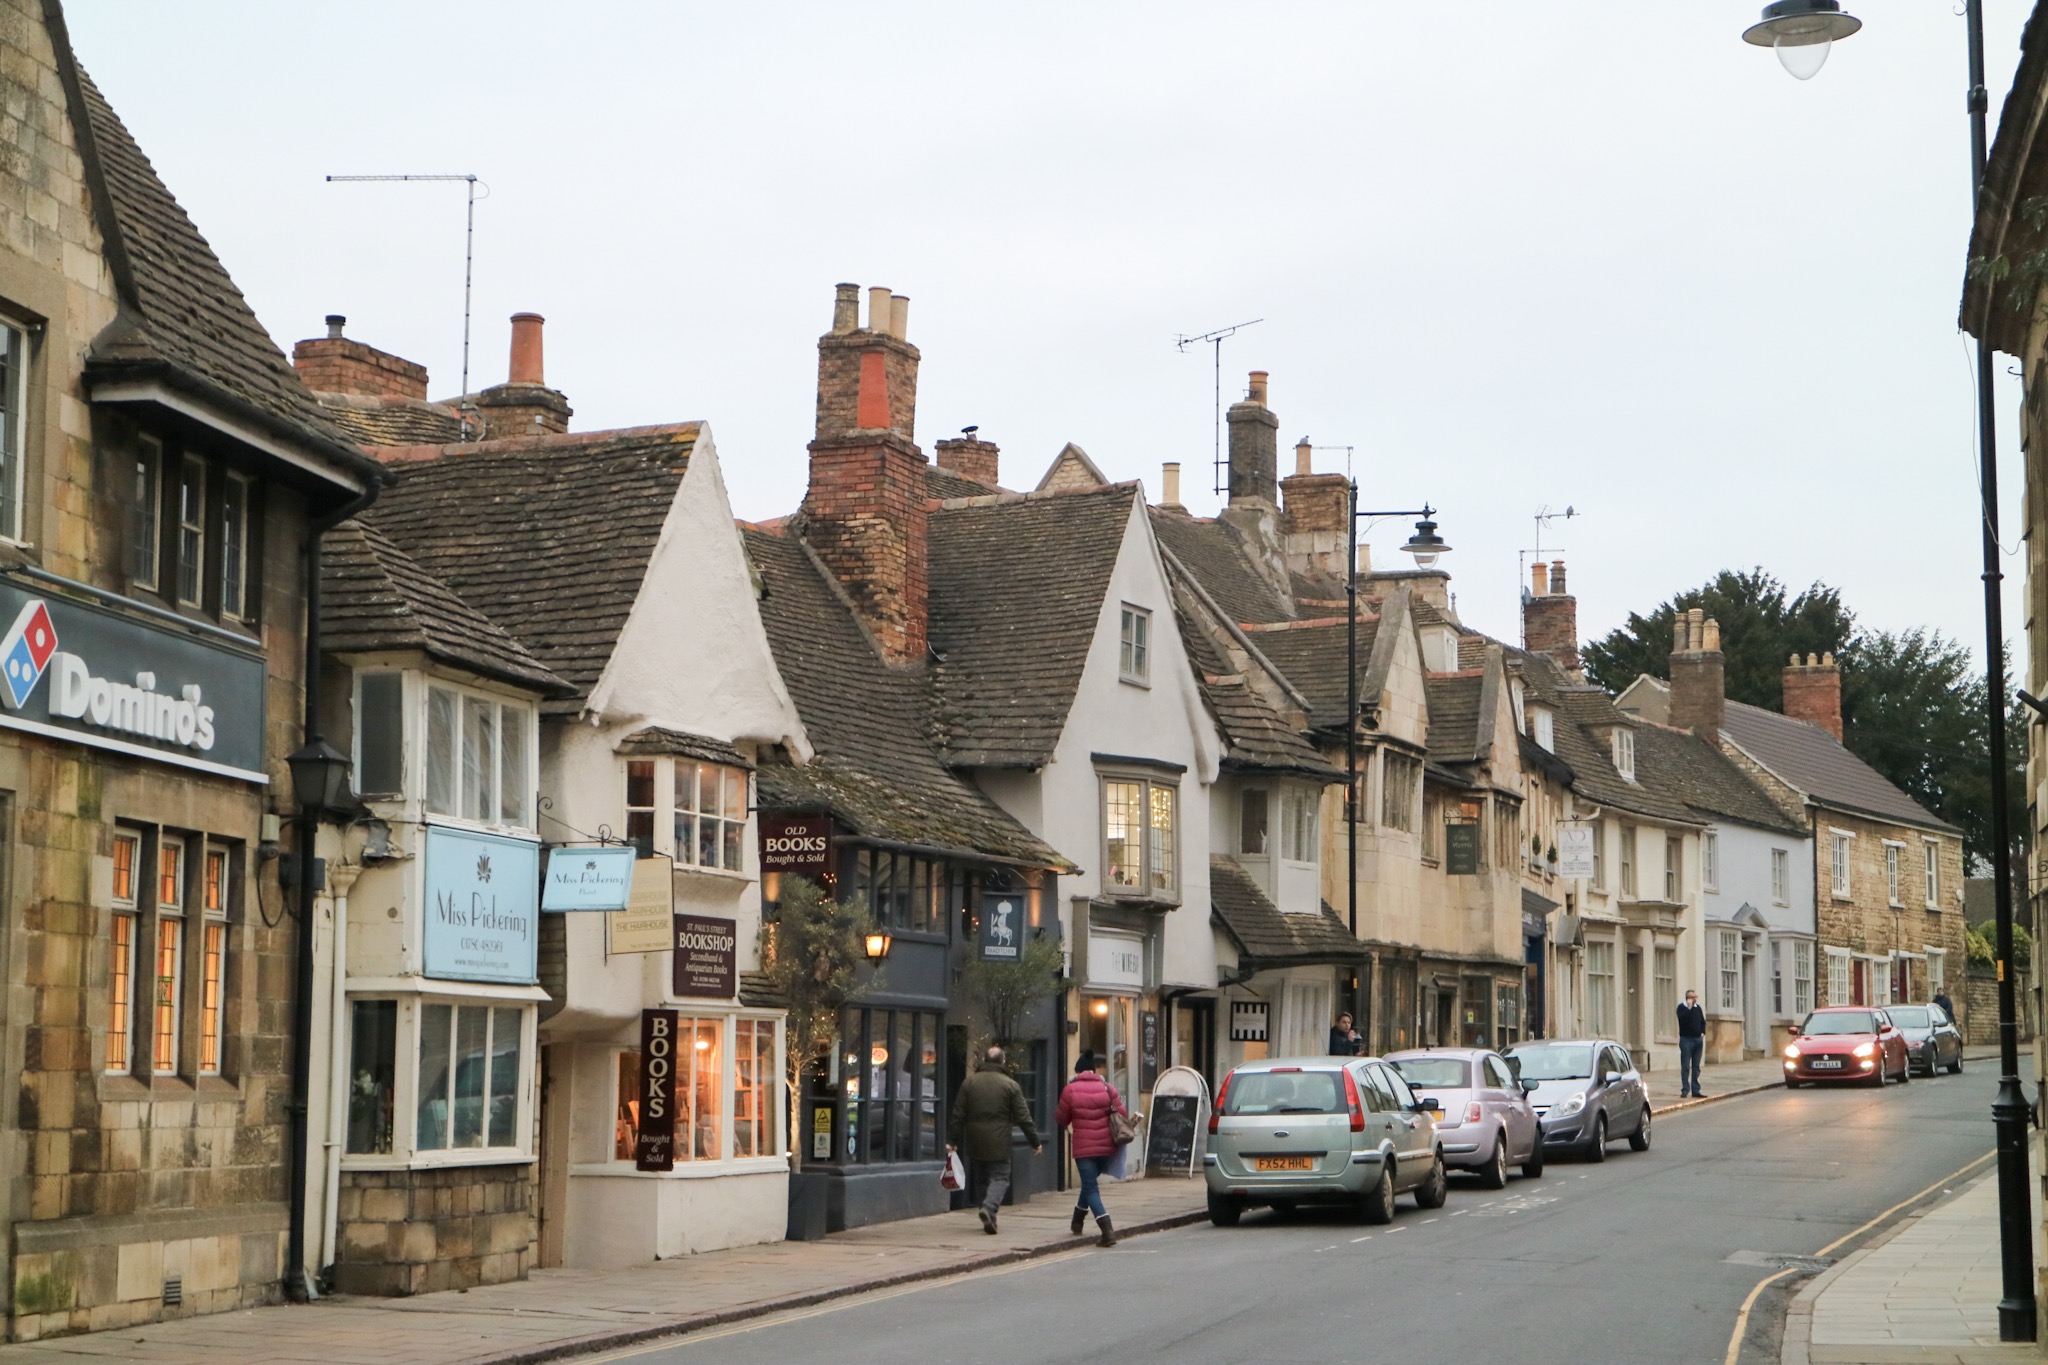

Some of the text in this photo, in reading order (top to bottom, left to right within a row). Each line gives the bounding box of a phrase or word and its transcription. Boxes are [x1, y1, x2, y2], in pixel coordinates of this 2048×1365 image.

[49, 652, 215, 750] Domino's
[785, 826, 807, 836] OLD
[765, 837, 827, 852] BOOKS
[766, 853, 825, 866] Bought & Sold
[555, 873, 577, 884] Miss
[580, 872, 624, 886] Pickering
[436, 888, 527, 942] Miss Pickering
[616, 920, 669, 931] THE HAIRHOUSE
[694, 924, 710, 933] PAUL'S
[710, 925, 727, 934] STREET
[679, 932, 734, 952] BOOKSHOP
[690, 952, 718, 963] Secondhand
[685, 963, 728, 975] Antiquarian Books
[648, 1017, 669, 1118] BOOKS
[641, 1134, 670, 1146] Bought
[651, 1145, 659, 1153] &
[645, 1154, 664, 1163] Sold
[1258, 1158, 1309, 1169] FX52 HHL
